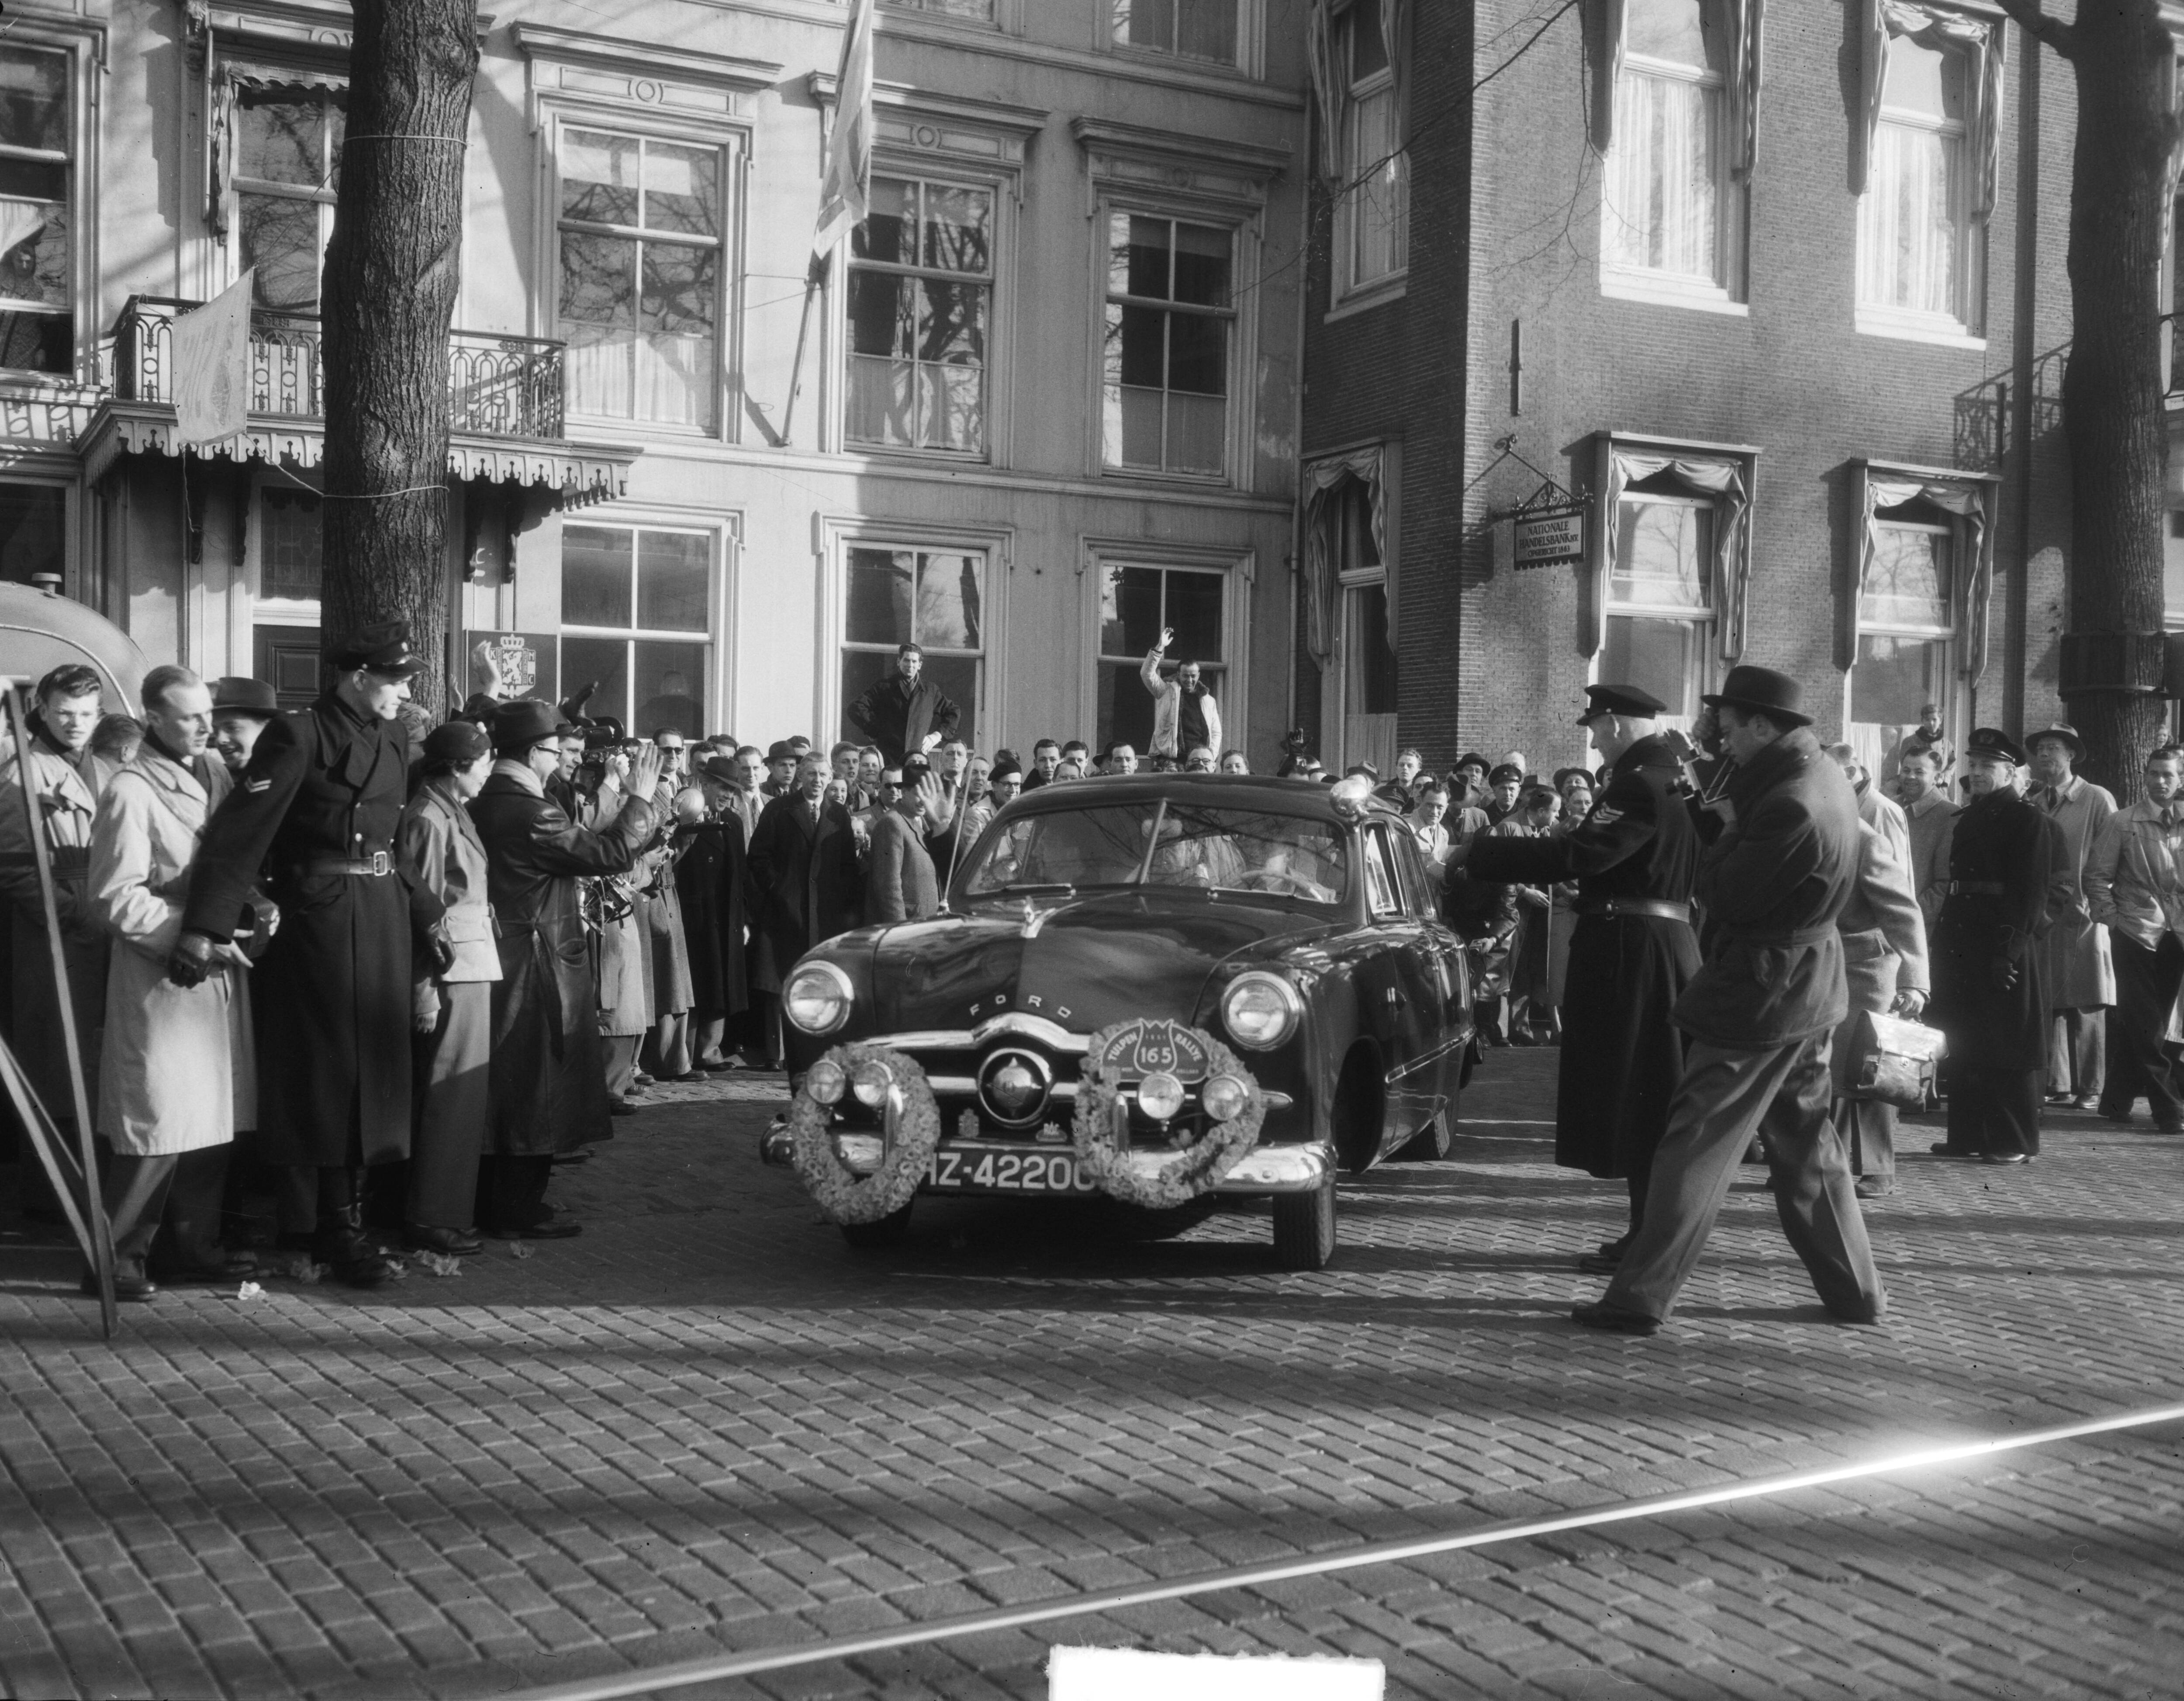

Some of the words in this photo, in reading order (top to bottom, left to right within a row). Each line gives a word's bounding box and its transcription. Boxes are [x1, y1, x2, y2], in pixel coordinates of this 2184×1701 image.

[1527, 521, 1569, 536] NATIONALE
[1519, 533, 1570, 549] HANDELSBANK
[970, 995, 1071, 1018] FORD
[1108, 1031, 1138, 1061] TULPEN
[1174, 1033, 1203, 1061] RALLYE
[1141, 1046, 1172, 1064] 165
